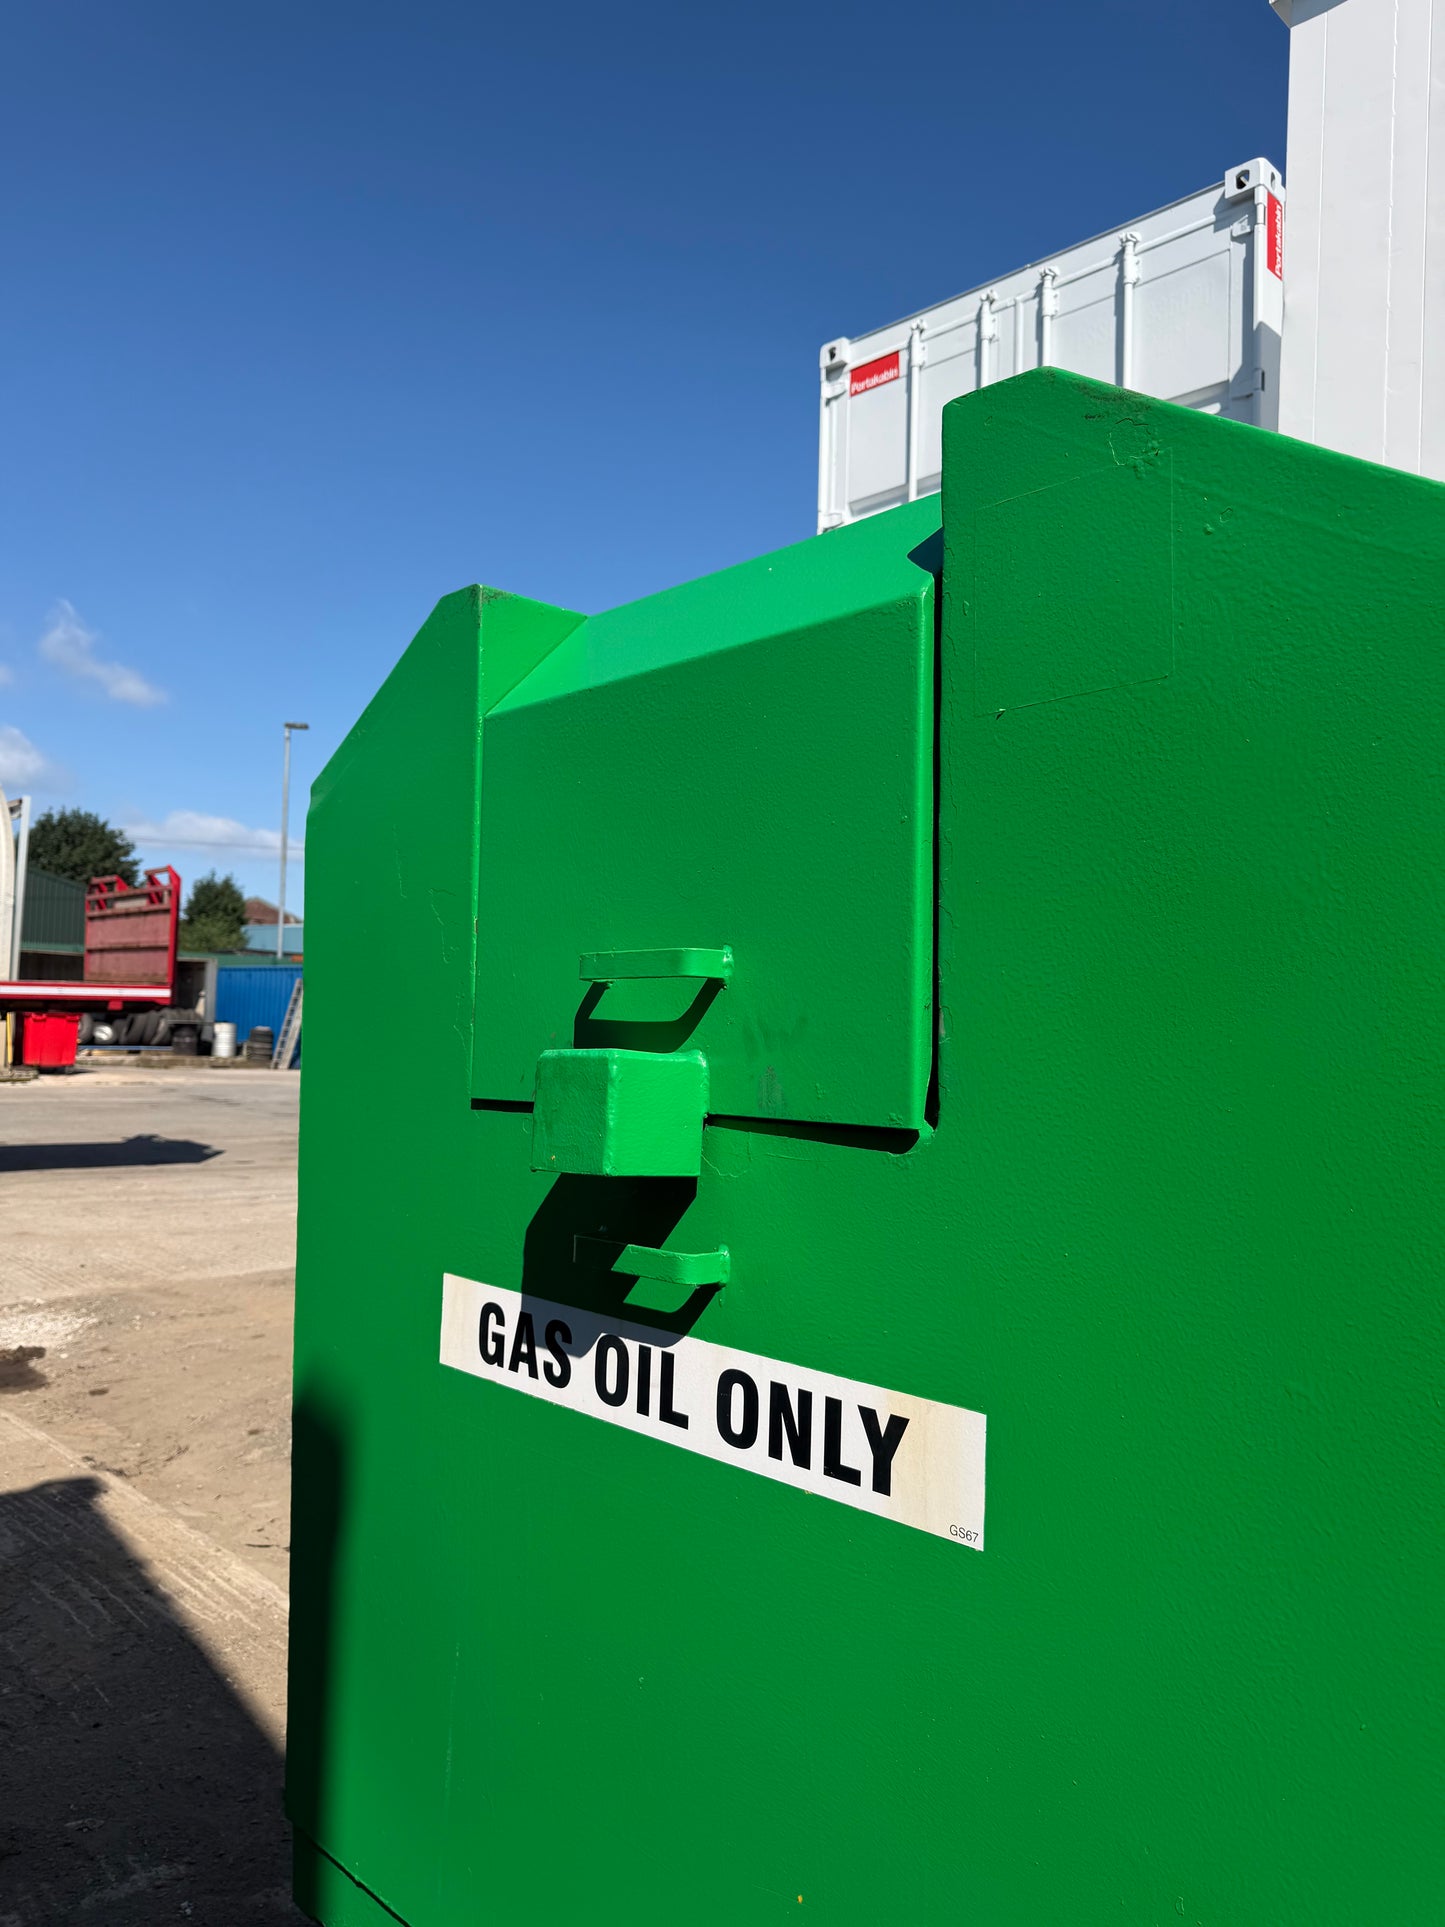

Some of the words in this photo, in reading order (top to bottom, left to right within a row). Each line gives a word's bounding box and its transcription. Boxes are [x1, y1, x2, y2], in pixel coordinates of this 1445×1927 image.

[1274, 202, 1282, 277] Portakabin
[851, 367, 898, 395] Portakabin
[478, 1302, 573, 1389] GAS
[594, 1333, 690, 1430] OIL
[716, 1368, 909, 1497] ONLY
[949, 1524, 979, 1543] GS67
